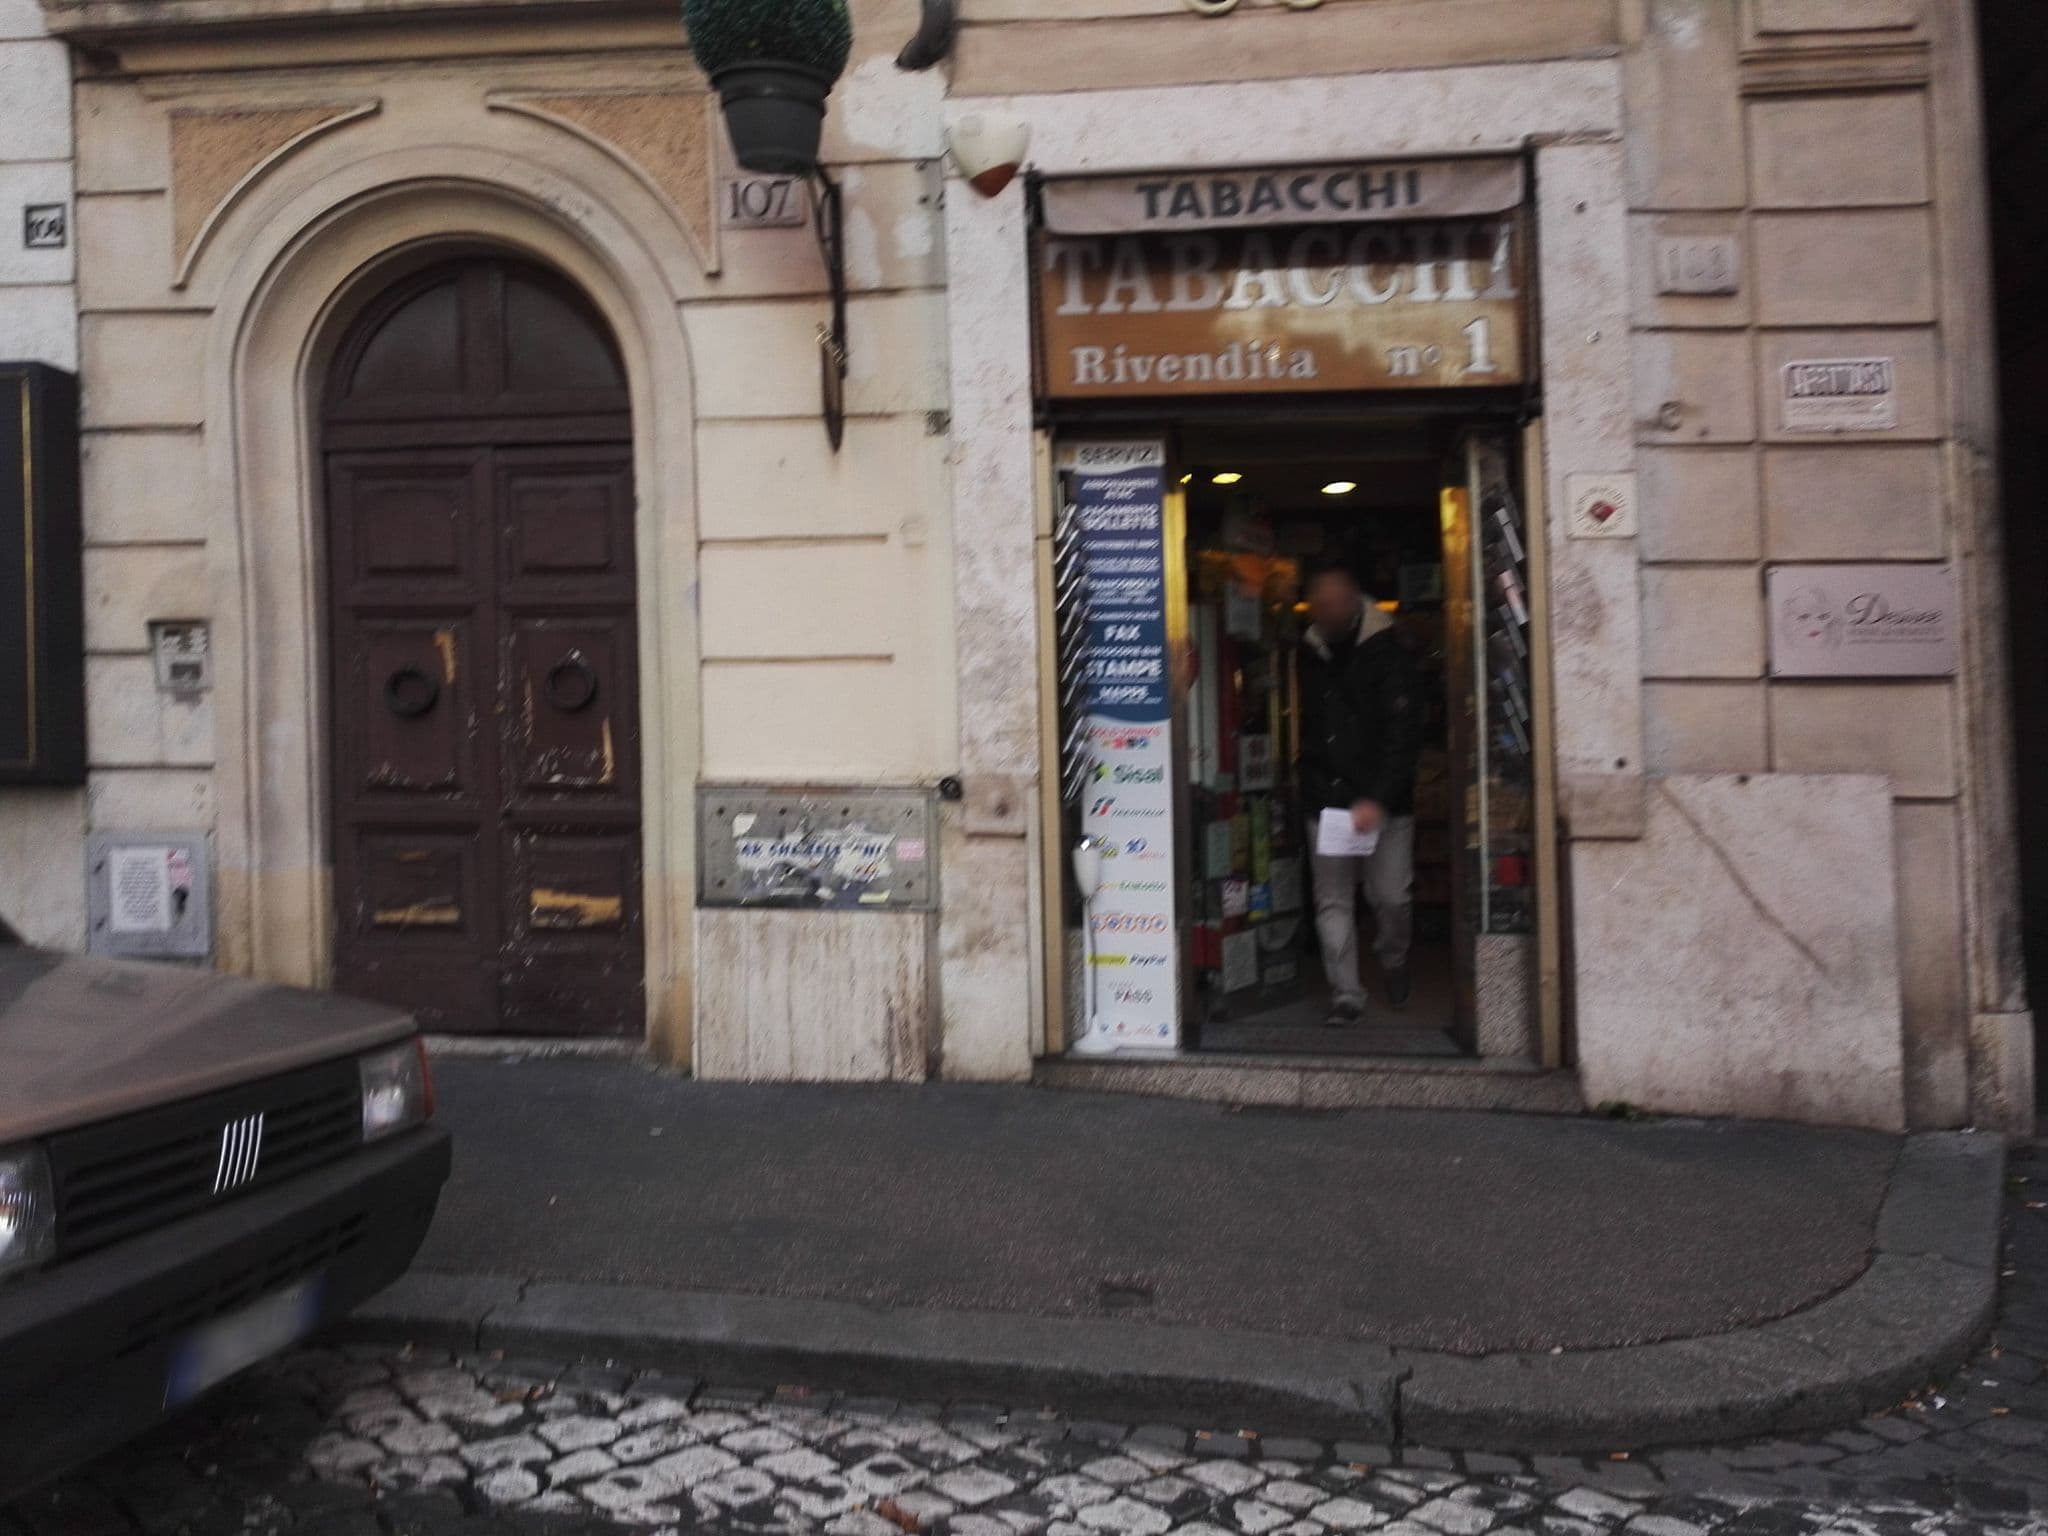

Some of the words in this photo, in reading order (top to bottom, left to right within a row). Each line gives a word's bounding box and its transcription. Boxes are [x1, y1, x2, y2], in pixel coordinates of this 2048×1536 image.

[729, 180, 792, 219] 107
[1137, 170, 1421, 219] TABACCHI
[1046, 221, 1519, 316] TABACCHI
[1071, 339, 1318, 386] Rivendita
[1462, 316, 1497, 375] 1
[1103, 625, 1141, 641] FAX
[1086, 659, 1163, 678] STAMPE
